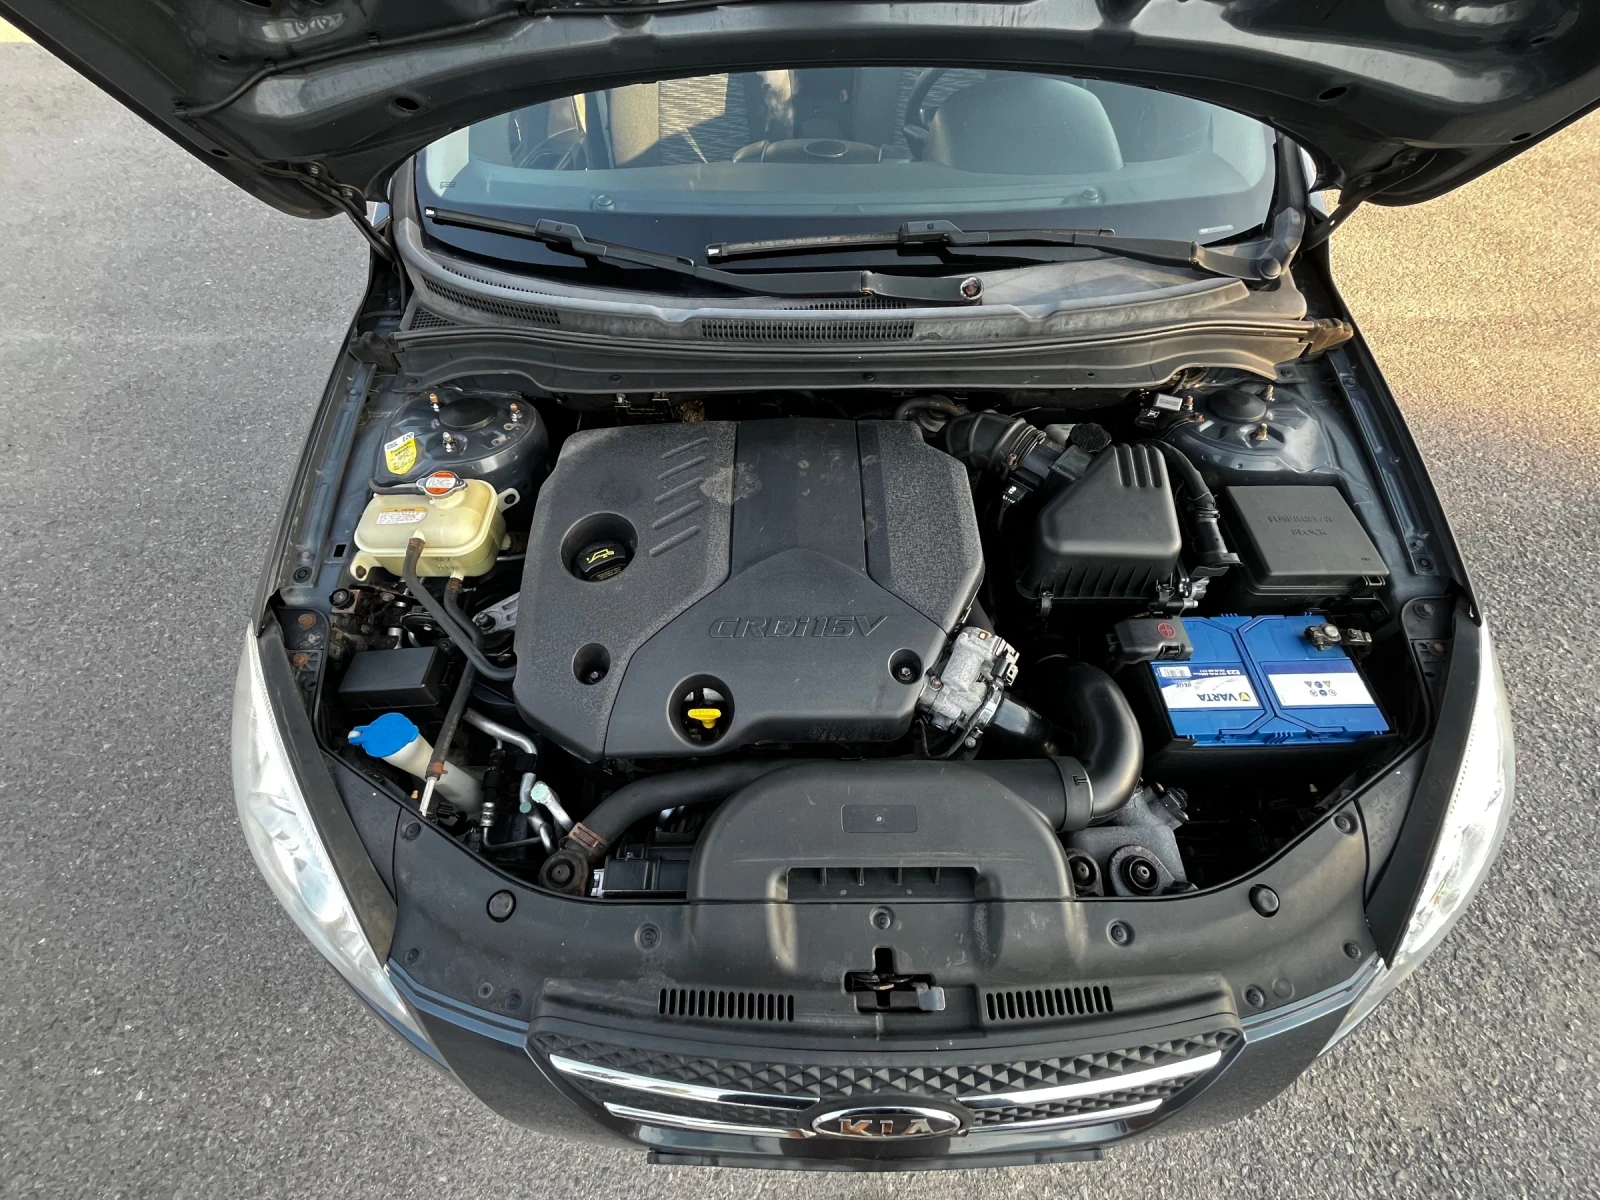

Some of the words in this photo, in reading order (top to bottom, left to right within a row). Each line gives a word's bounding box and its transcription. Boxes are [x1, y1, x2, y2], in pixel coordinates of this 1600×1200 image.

[1290, 528, 1328, 536] BLOCK
[1197, 694, 1238, 702] VARTA
[838, 1118, 934, 1137] KIA
